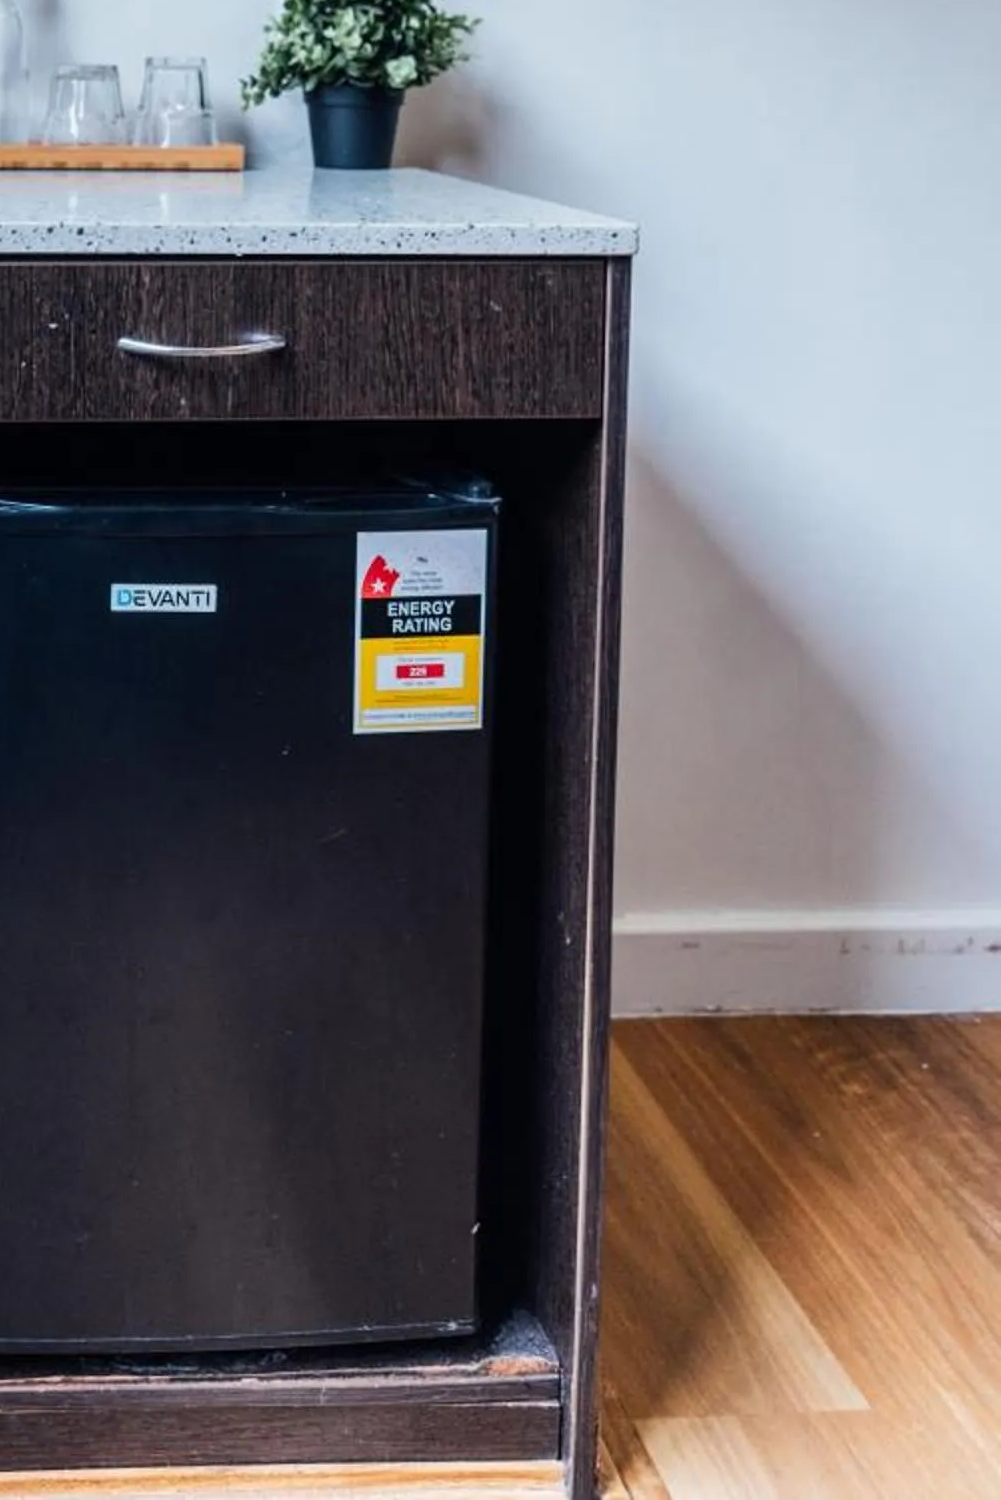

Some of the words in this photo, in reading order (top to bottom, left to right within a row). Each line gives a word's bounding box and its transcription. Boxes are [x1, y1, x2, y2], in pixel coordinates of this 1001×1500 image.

[117, 589, 210, 607] DEVANTI
[387, 600, 455, 617] ENERGY
[392, 617, 452, 633] RATING
